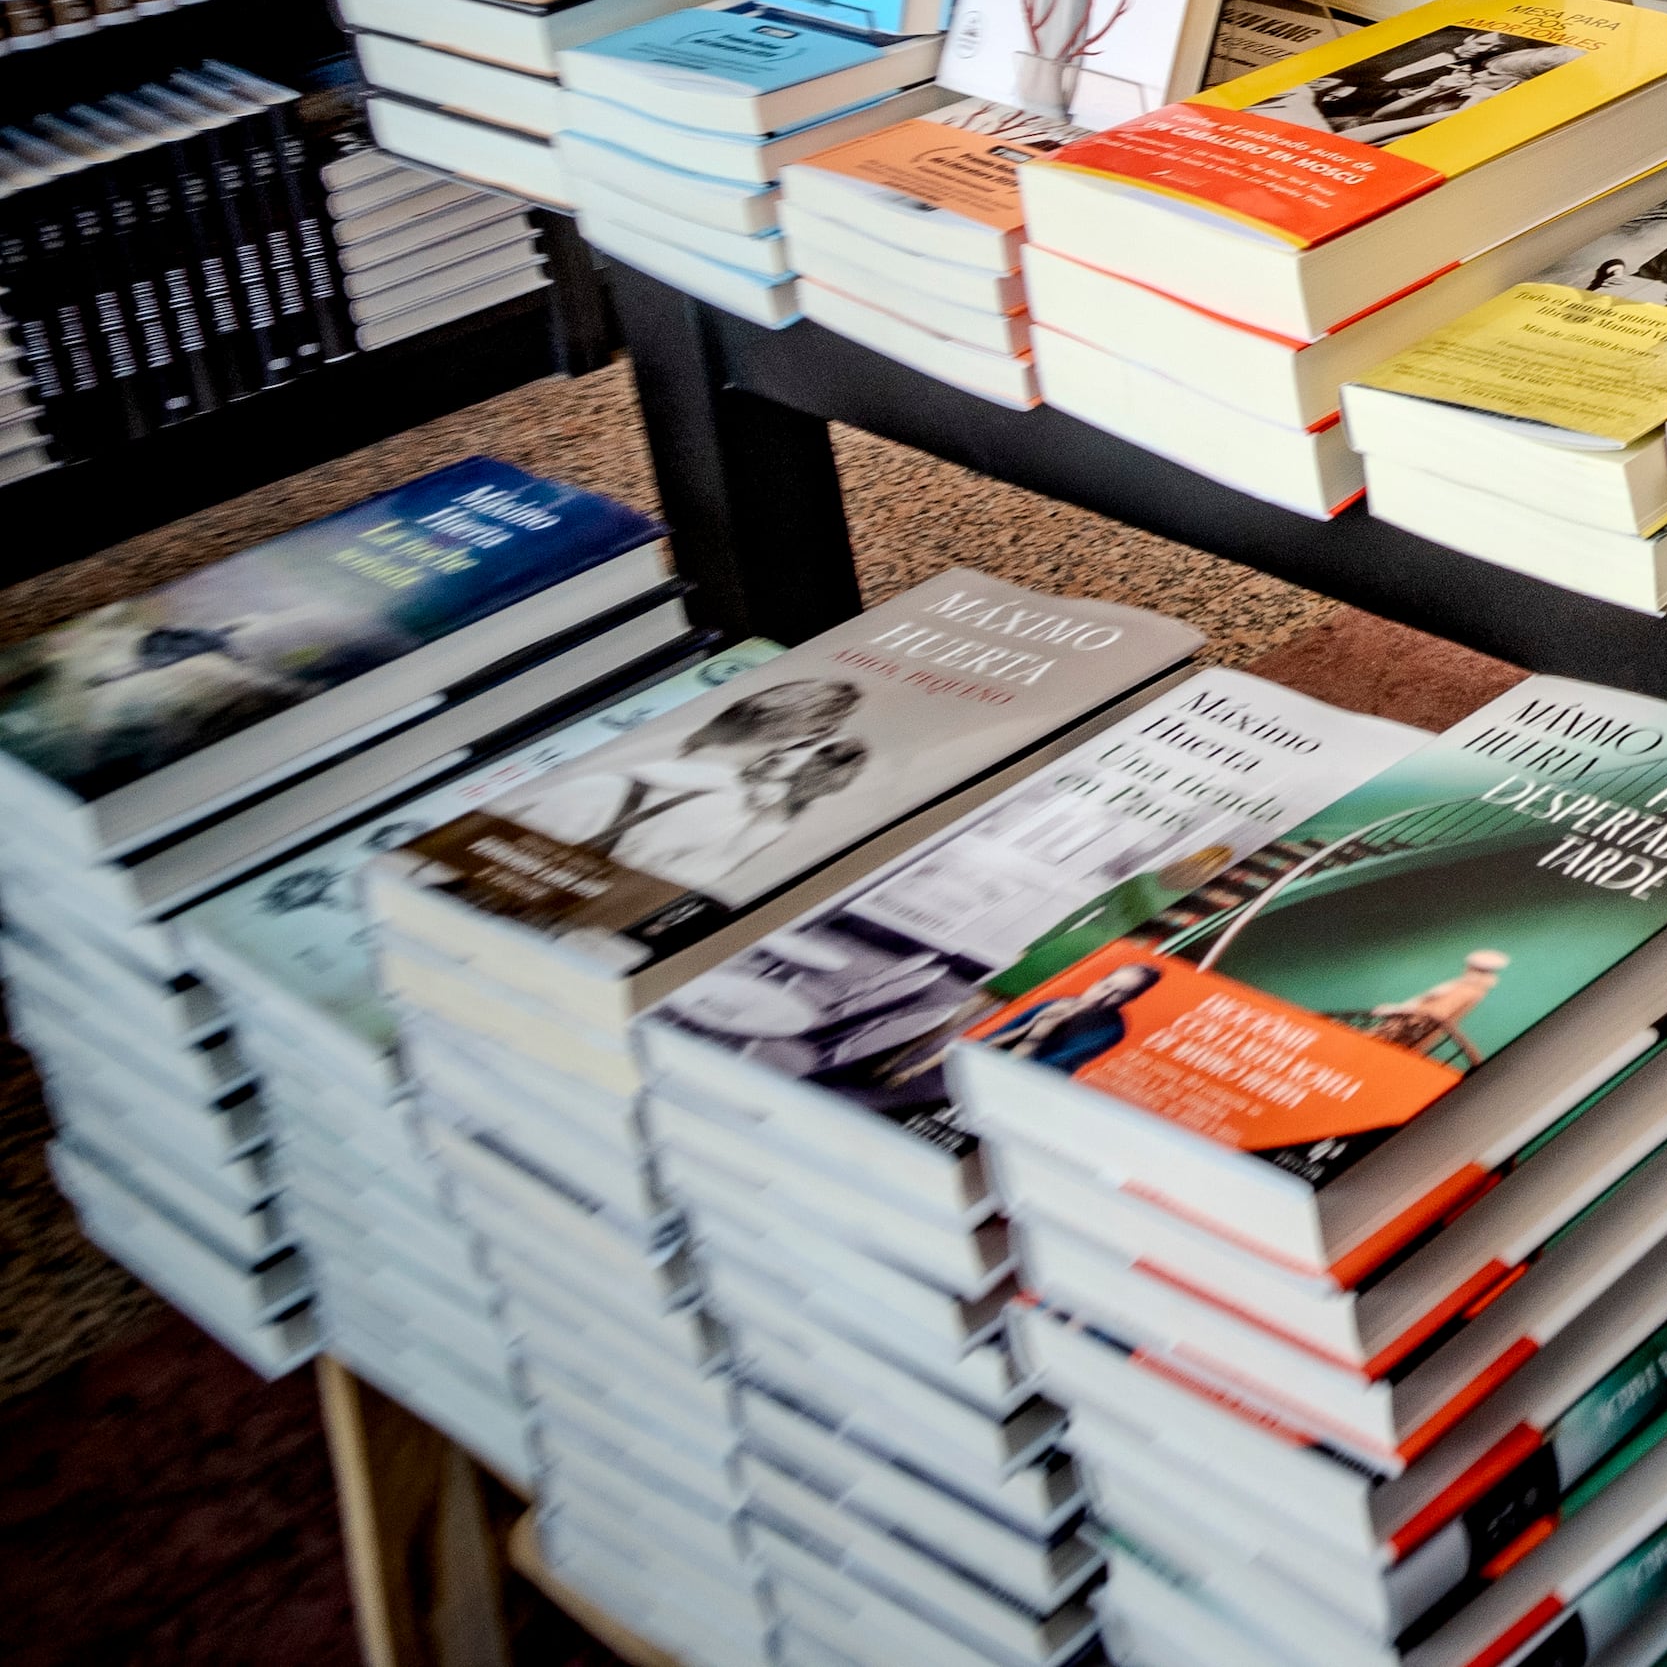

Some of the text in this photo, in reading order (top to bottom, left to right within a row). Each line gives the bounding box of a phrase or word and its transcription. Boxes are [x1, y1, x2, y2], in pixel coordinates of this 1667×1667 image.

[1456, 17, 1607, 50] AMOR TOWLES
[1506, 5, 1622, 31] MESA PARA
[1523, 17, 1571, 30] DOS
[1143, 120, 1368, 185] UN CABALLERO EN MOSCÚ
[1514, 289, 1551, 306] Todo
[1552, 297, 1569, 309] el
[1570, 301, 1619, 321] mundo
[923, 590, 1124, 652] MÁXIMO
[867, 621, 1058, 686] HUERTA
[1139, 715, 1262, 774] Huerta
[1177, 690, 1324, 755] Máximo
[1504, 698, 1664, 756] MÁXIMO
[1097, 741, 1286, 823] Una tienda
[1461, 725, 1600, 783] HUERTA
[1054, 774, 1198, 832] en París
